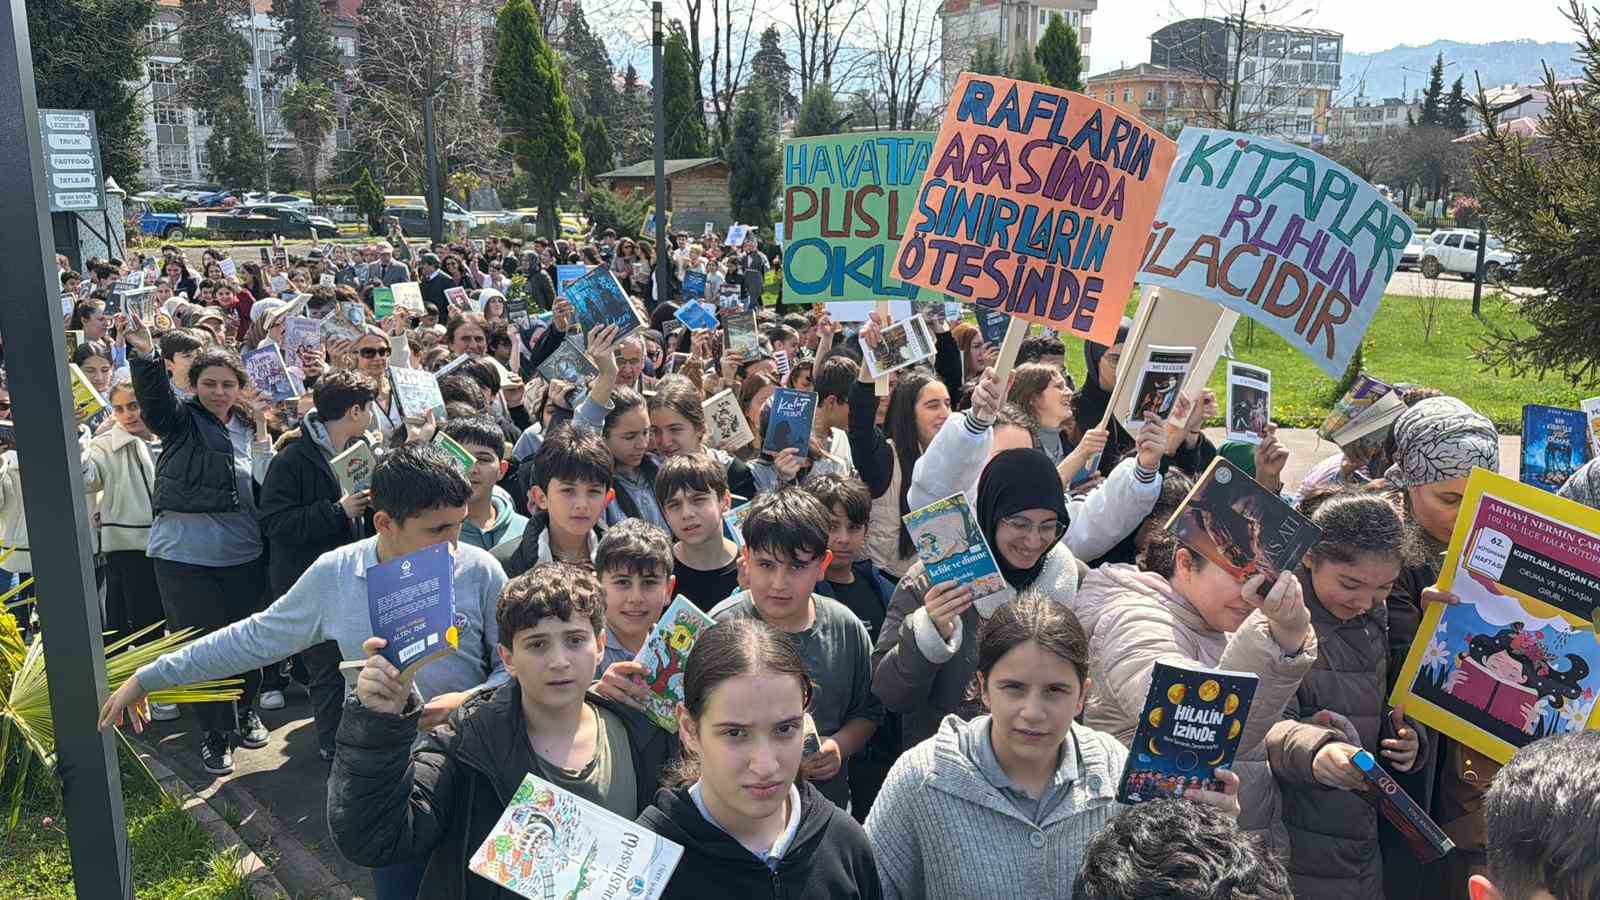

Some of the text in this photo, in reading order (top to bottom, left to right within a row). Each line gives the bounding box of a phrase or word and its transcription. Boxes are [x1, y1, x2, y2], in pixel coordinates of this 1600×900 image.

[957, 79, 1155, 182] RAFLARIN
[785, 137, 934, 189] HAYATTA
[934, 131, 1126, 221] ARASINDA
[785, 184, 905, 241] PUSL
[916, 178, 1113, 273] SINIRLARIN
[1178, 134, 1414, 284] KİTAPLAR
[1218, 193, 1373, 307] RUHUN
[897, 231, 1105, 332] ÖTESİNDE
[1138, 220, 1352, 361] İLACIDIR
[1488, 503, 1600, 552] ARHAVİ NERMİN ÇAR
[1567, 545, 1600, 564] KÜTÜP
[1512, 549, 1600, 592] KURTLARLA KOŞAN KA
[1519, 567, 1594, 605] OKUMA VE PAYLAŞIM
[1537, 586, 1565, 603] GRUBU
[1172, 722, 1217, 743] İZİNDE
[1174, 703, 1225, 725] HİLALİN
